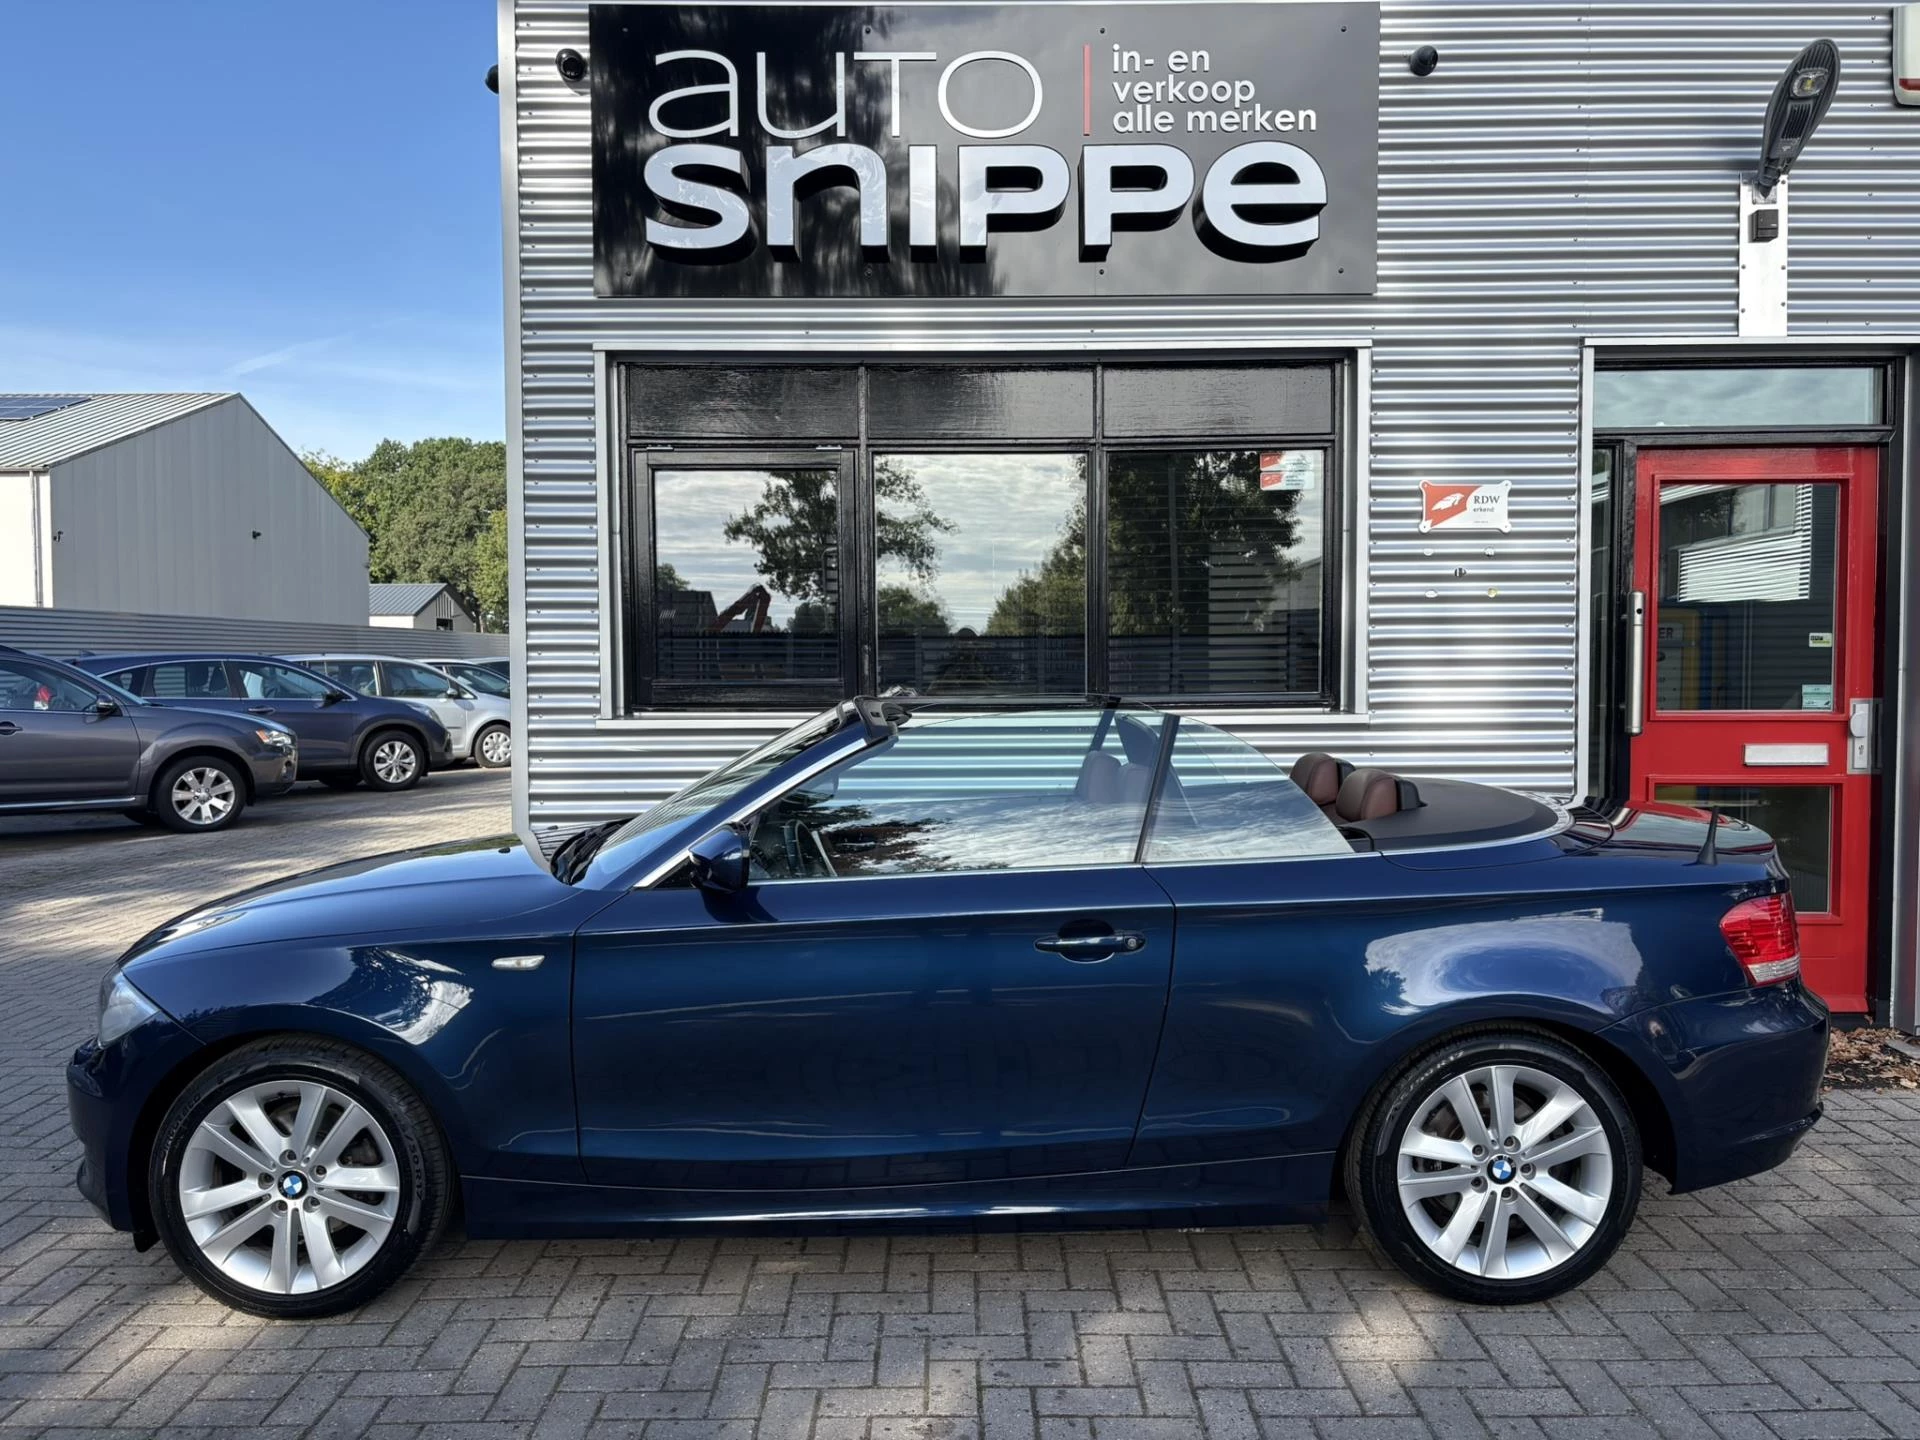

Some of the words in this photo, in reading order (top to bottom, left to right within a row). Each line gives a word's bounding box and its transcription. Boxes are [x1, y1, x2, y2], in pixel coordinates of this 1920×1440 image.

[1111, 43, 1155, 73] in-
[1167, 49, 1211, 73] en
[1111, 75, 1256, 110] verkoop
[1111, 104, 1180, 133] alle
[1186, 104, 1318, 133] merken
[1473, 495, 1500, 505] RDW
